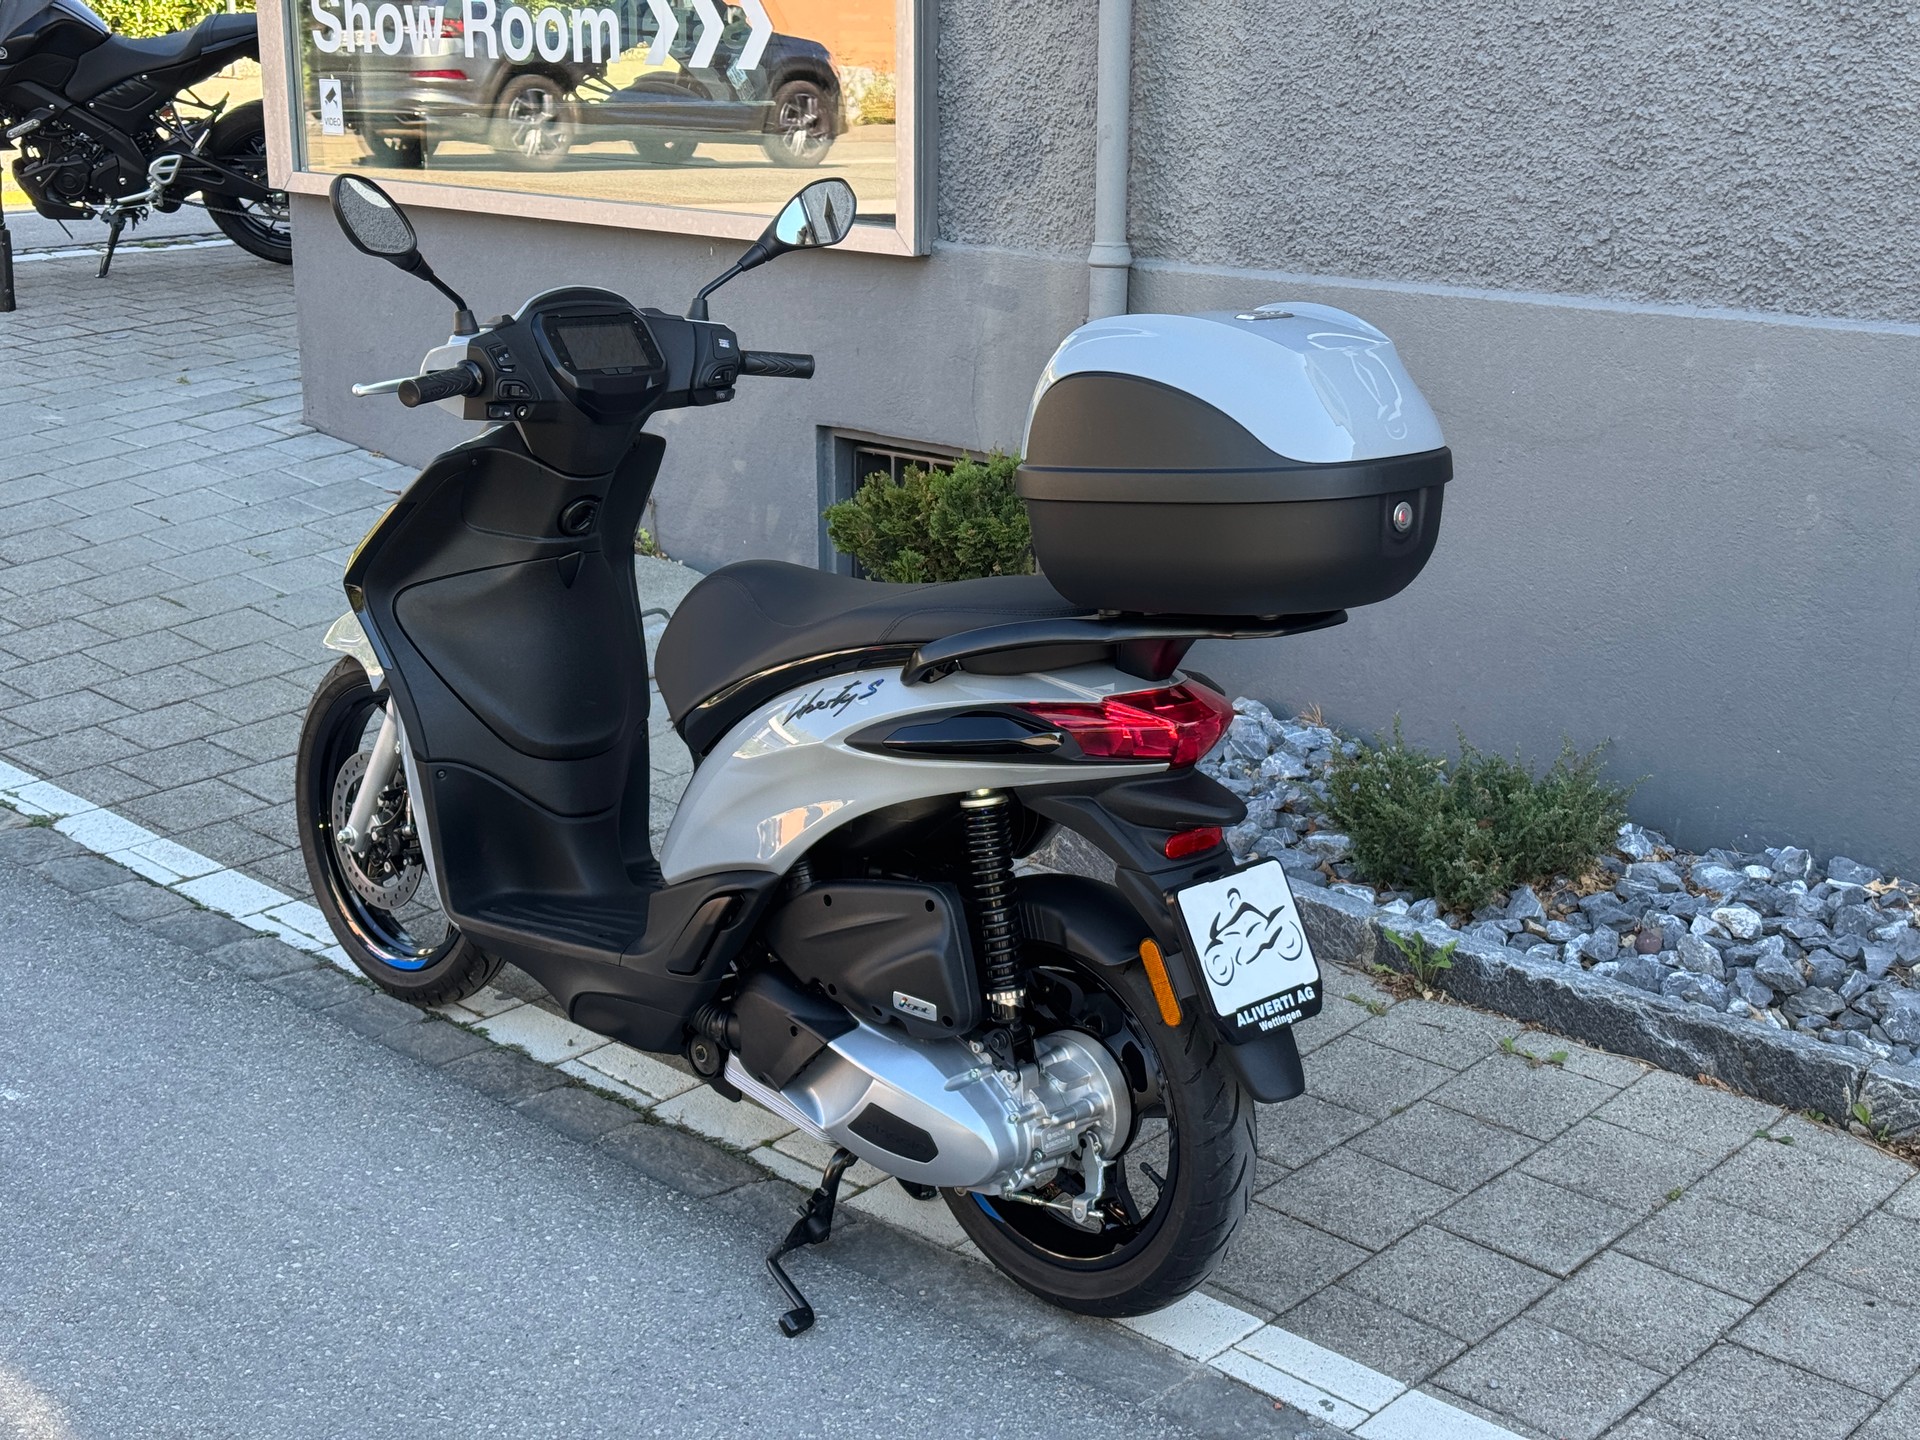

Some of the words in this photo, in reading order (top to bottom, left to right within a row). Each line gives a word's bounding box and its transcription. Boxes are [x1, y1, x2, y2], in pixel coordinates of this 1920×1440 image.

[311, 0, 444, 56] Show
[462, 0, 620, 63] Room
[324, 117, 341, 127] VIDEO
[858, 678, 884, 700] S
[1236, 994, 1295, 1027] ALIVERTI
[1296, 986, 1316, 1002] AG
[1259, 1008, 1302, 1032] Wettingen
